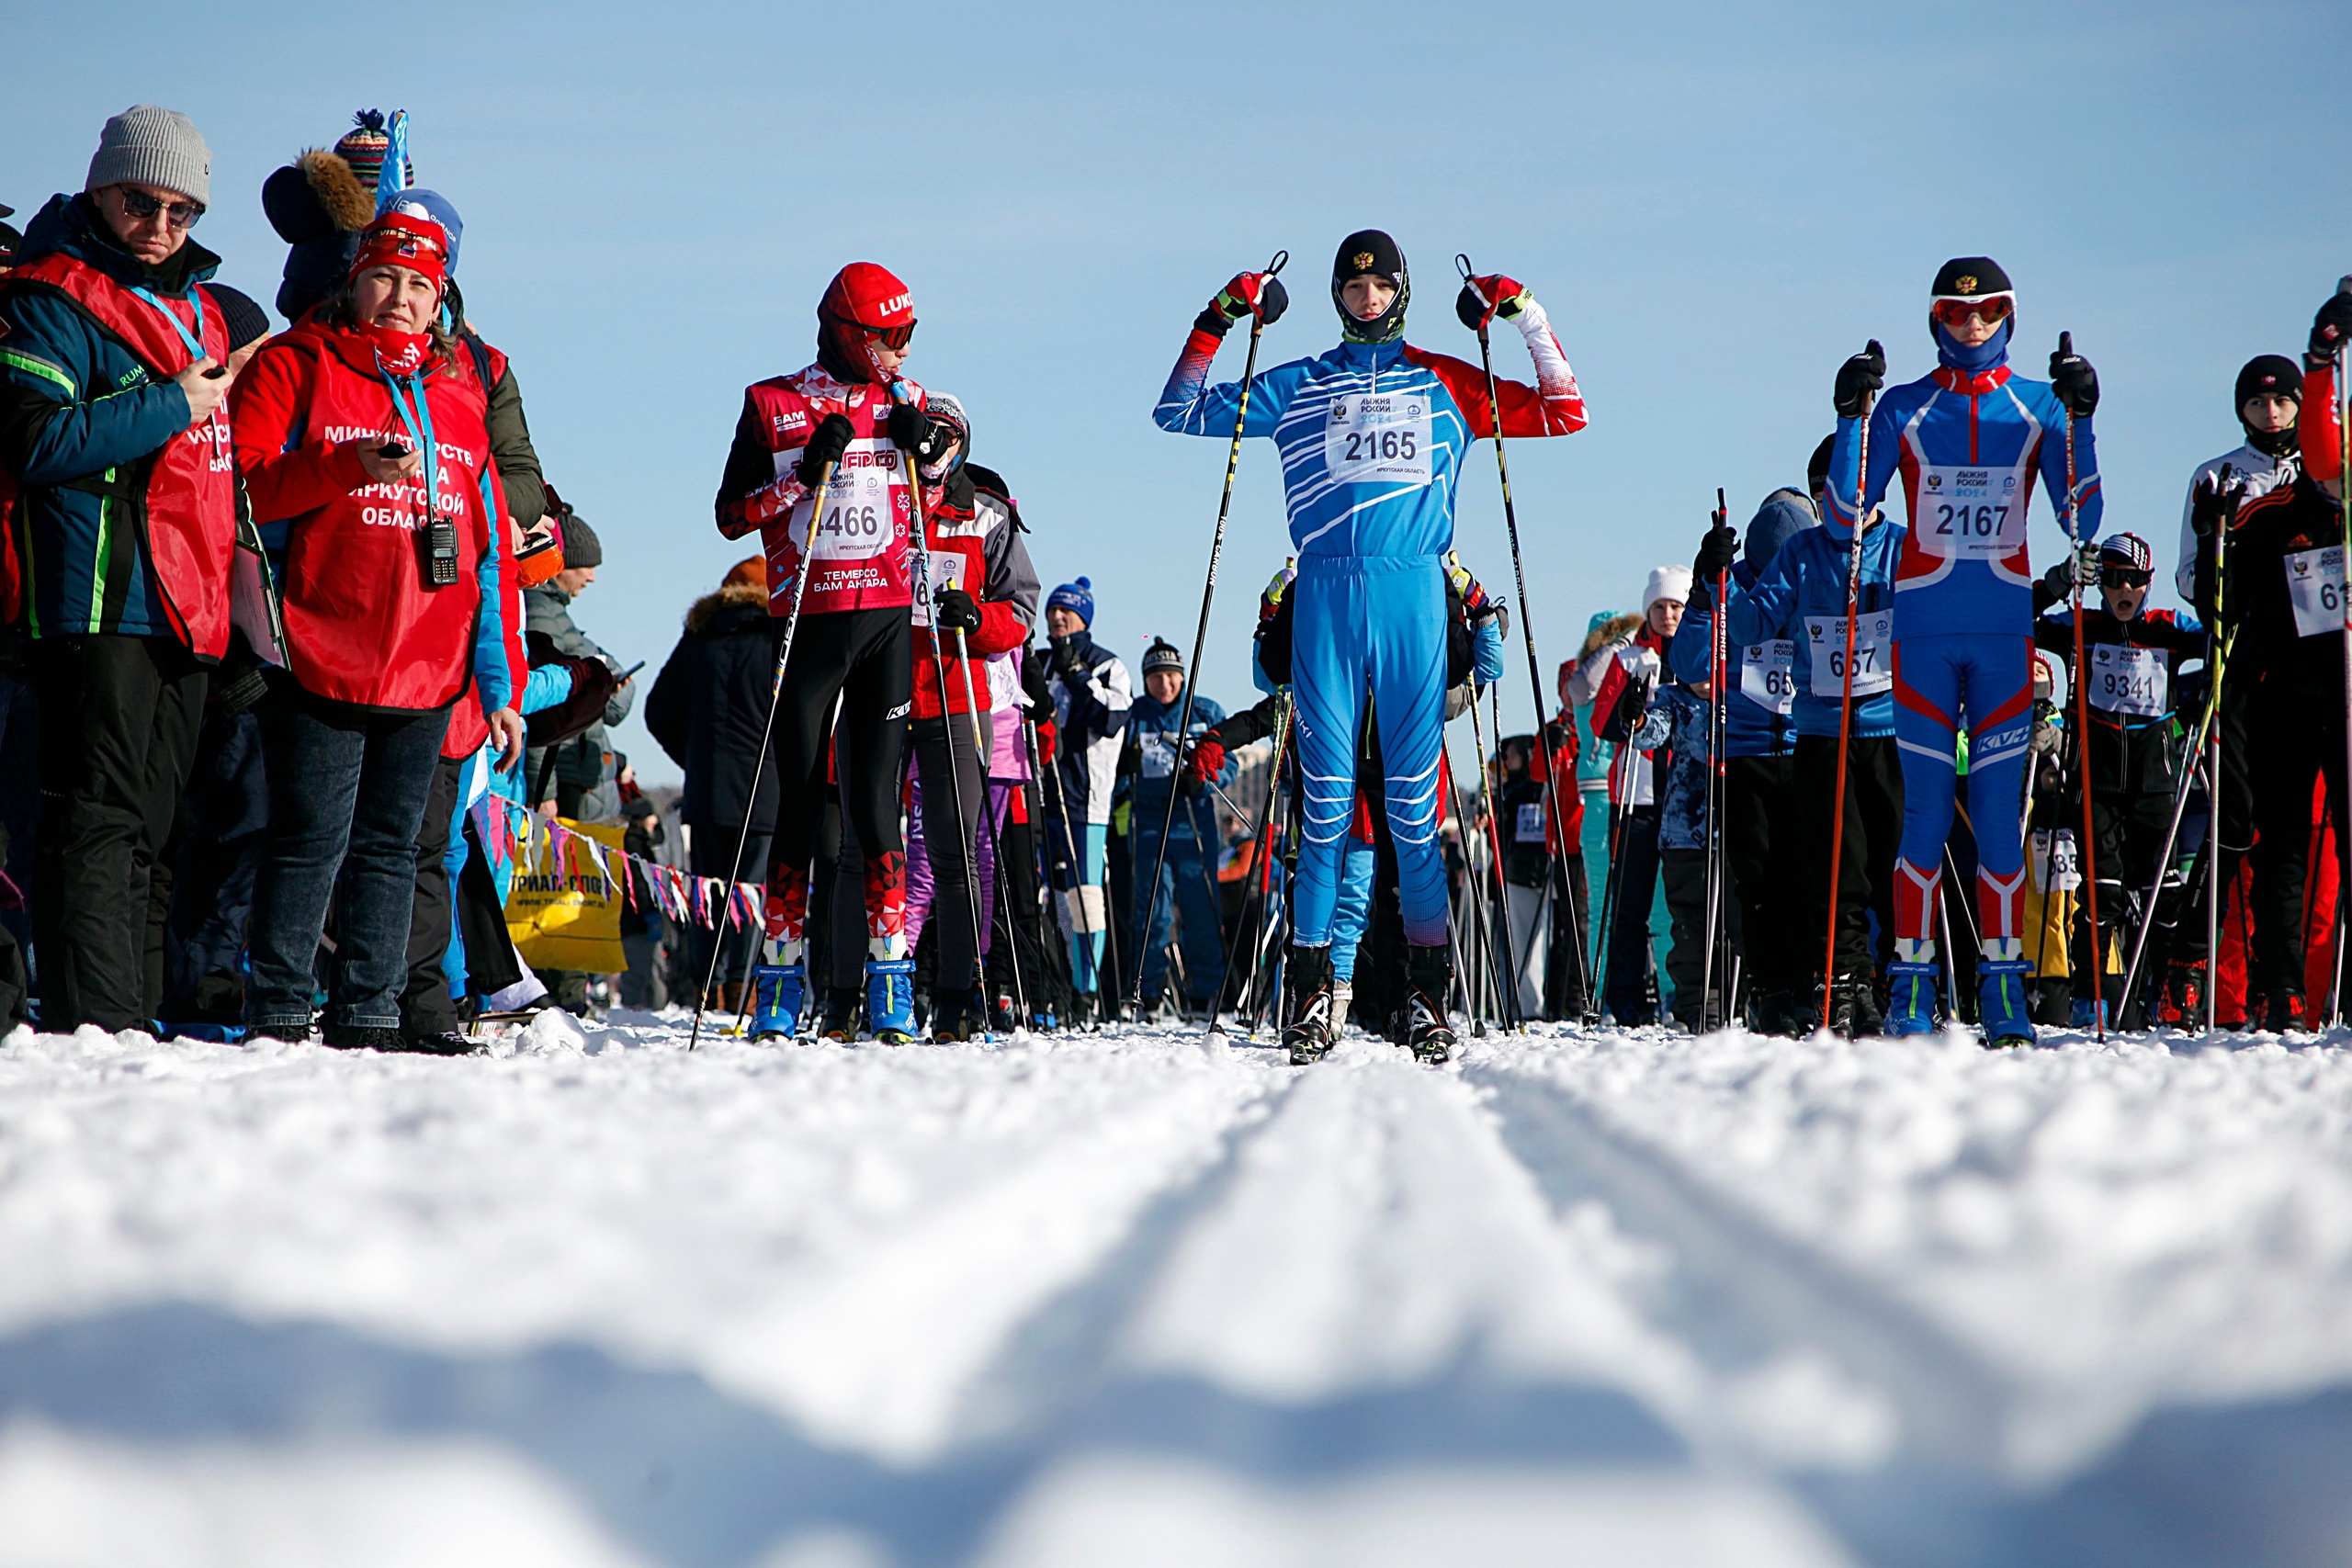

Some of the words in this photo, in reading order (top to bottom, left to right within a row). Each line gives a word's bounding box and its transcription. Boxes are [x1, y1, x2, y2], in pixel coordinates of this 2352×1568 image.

[774, 411, 806, 426] БАМ
[1362, 414, 1392, 423] 2024
[1861, 418, 1870, 457] WORLD
[1345, 430, 1416, 461] 2165
[829, 472, 854, 481] ЫЖНЯ
[1404, 467, 1425, 475] ОБЛАСТЬ
[1956, 488, 1987, 497] 2024
[1936, 504, 2009, 536] 2167
[1208, 544, 1222, 586] CARBON
[823, 568, 878, 581] ТЕМЕРСО
[813, 581, 842, 592] БАМ
[846, 578, 888, 590] АНГАРА
[1836, 636, 1862, 644] 204
[1830, 647, 1876, 677] 657
[2104, 673, 2154, 699] 9341
